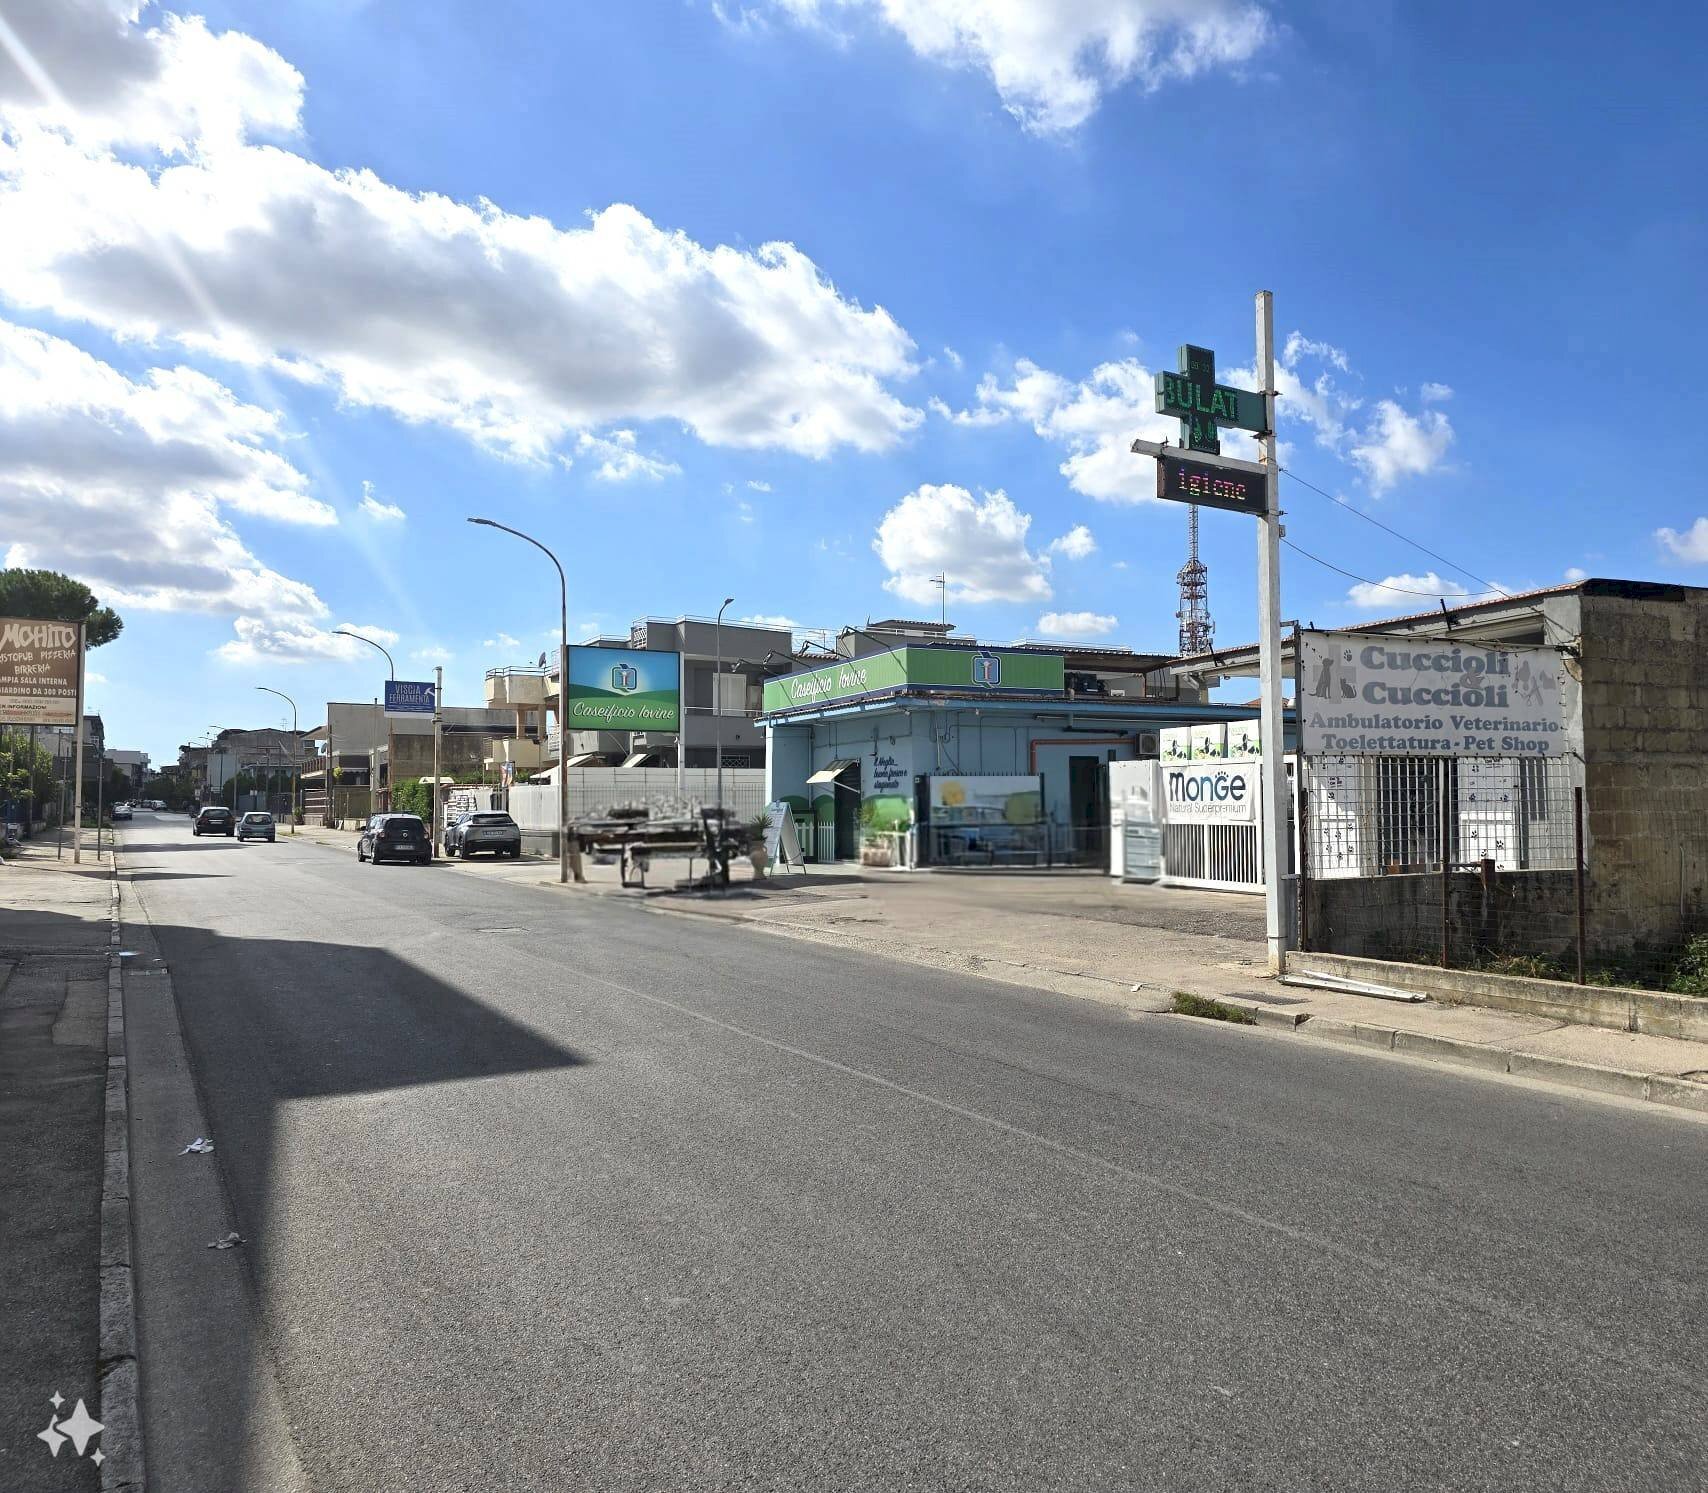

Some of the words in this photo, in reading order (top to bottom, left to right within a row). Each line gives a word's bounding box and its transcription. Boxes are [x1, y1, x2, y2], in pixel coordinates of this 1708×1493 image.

[41, 648, 76, 660] PIZZERIA
[1360, 645, 1511, 675] Cuccioli
[14, 663, 50, 674] BIRRERIA
[1459, 668, 1486, 690] &
[0, 675, 19, 684] MPIA
[20, 676, 37, 685] SALA
[38, 677, 68, 686] INTERNA
[791, 672, 832, 703] Caseificio
[0, 686, 31, 695] IARDINO
[32, 687, 42, 695] DA
[43, 687, 57, 696] 300
[58, 688, 77, 697] POSTI
[389, 693, 430, 704] FERRAMENTA
[1362, 681, 1510, 708] Cuccioli
[573, 701, 635, 722] Caseificio
[1309, 711, 1444, 730] Ambulatorio
[1449, 715, 1559, 732] Veterinario
[1321, 733, 1451, 750] Toelettatura
[1463, 735, 1496, 751] Pet
[1501, 735, 1550, 754] Shop
[1169, 802, 1192, 813] Natural
[1194, 802, 1247, 815] Superpremium
